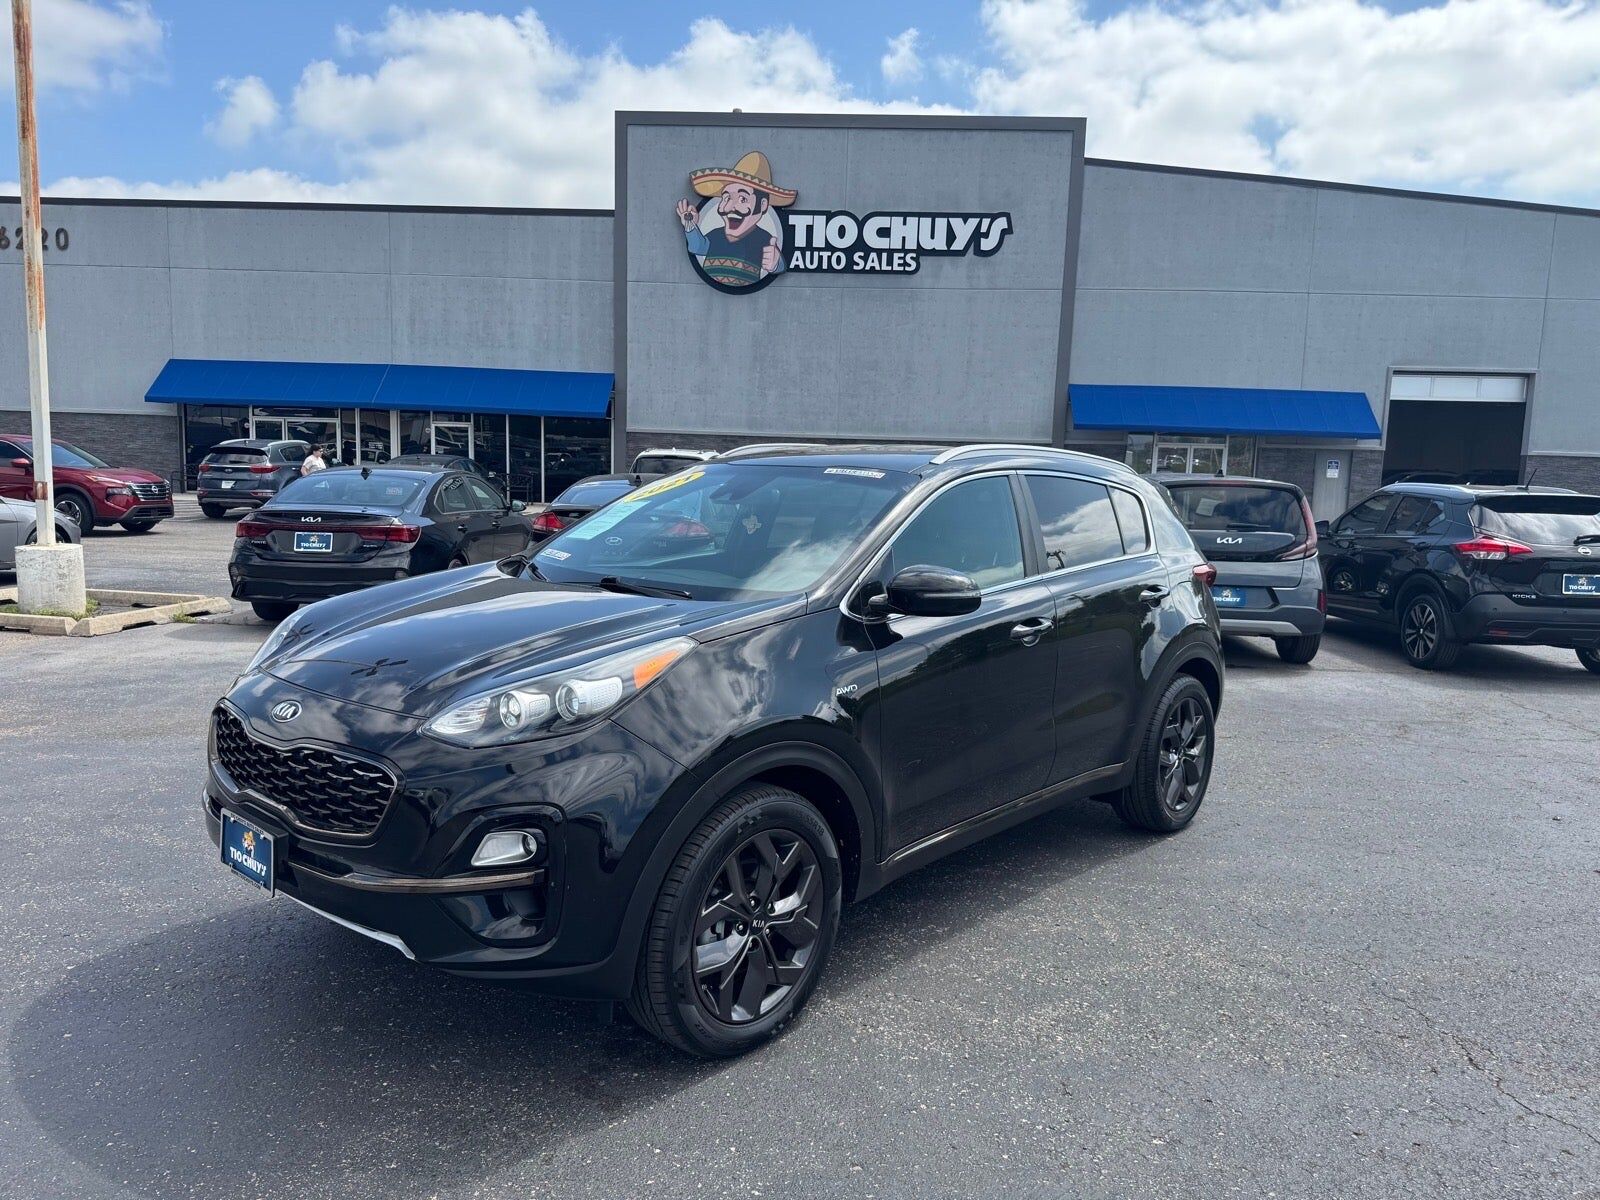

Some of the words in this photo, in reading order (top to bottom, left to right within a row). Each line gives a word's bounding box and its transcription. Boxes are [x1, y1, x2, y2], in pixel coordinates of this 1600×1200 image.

[788, 214, 859, 249] TIO
[862, 216, 1009, 251] CHUY'S
[789, 251, 847, 270] AUTO
[853, 251, 917, 272] SALES
[836, 684, 858, 696] AWD
[273, 702, 296, 719] KIA
[229, 846, 242, 863] TIO
[242, 853, 267, 877] CHUY'S
[752, 919, 765, 928] KIA
